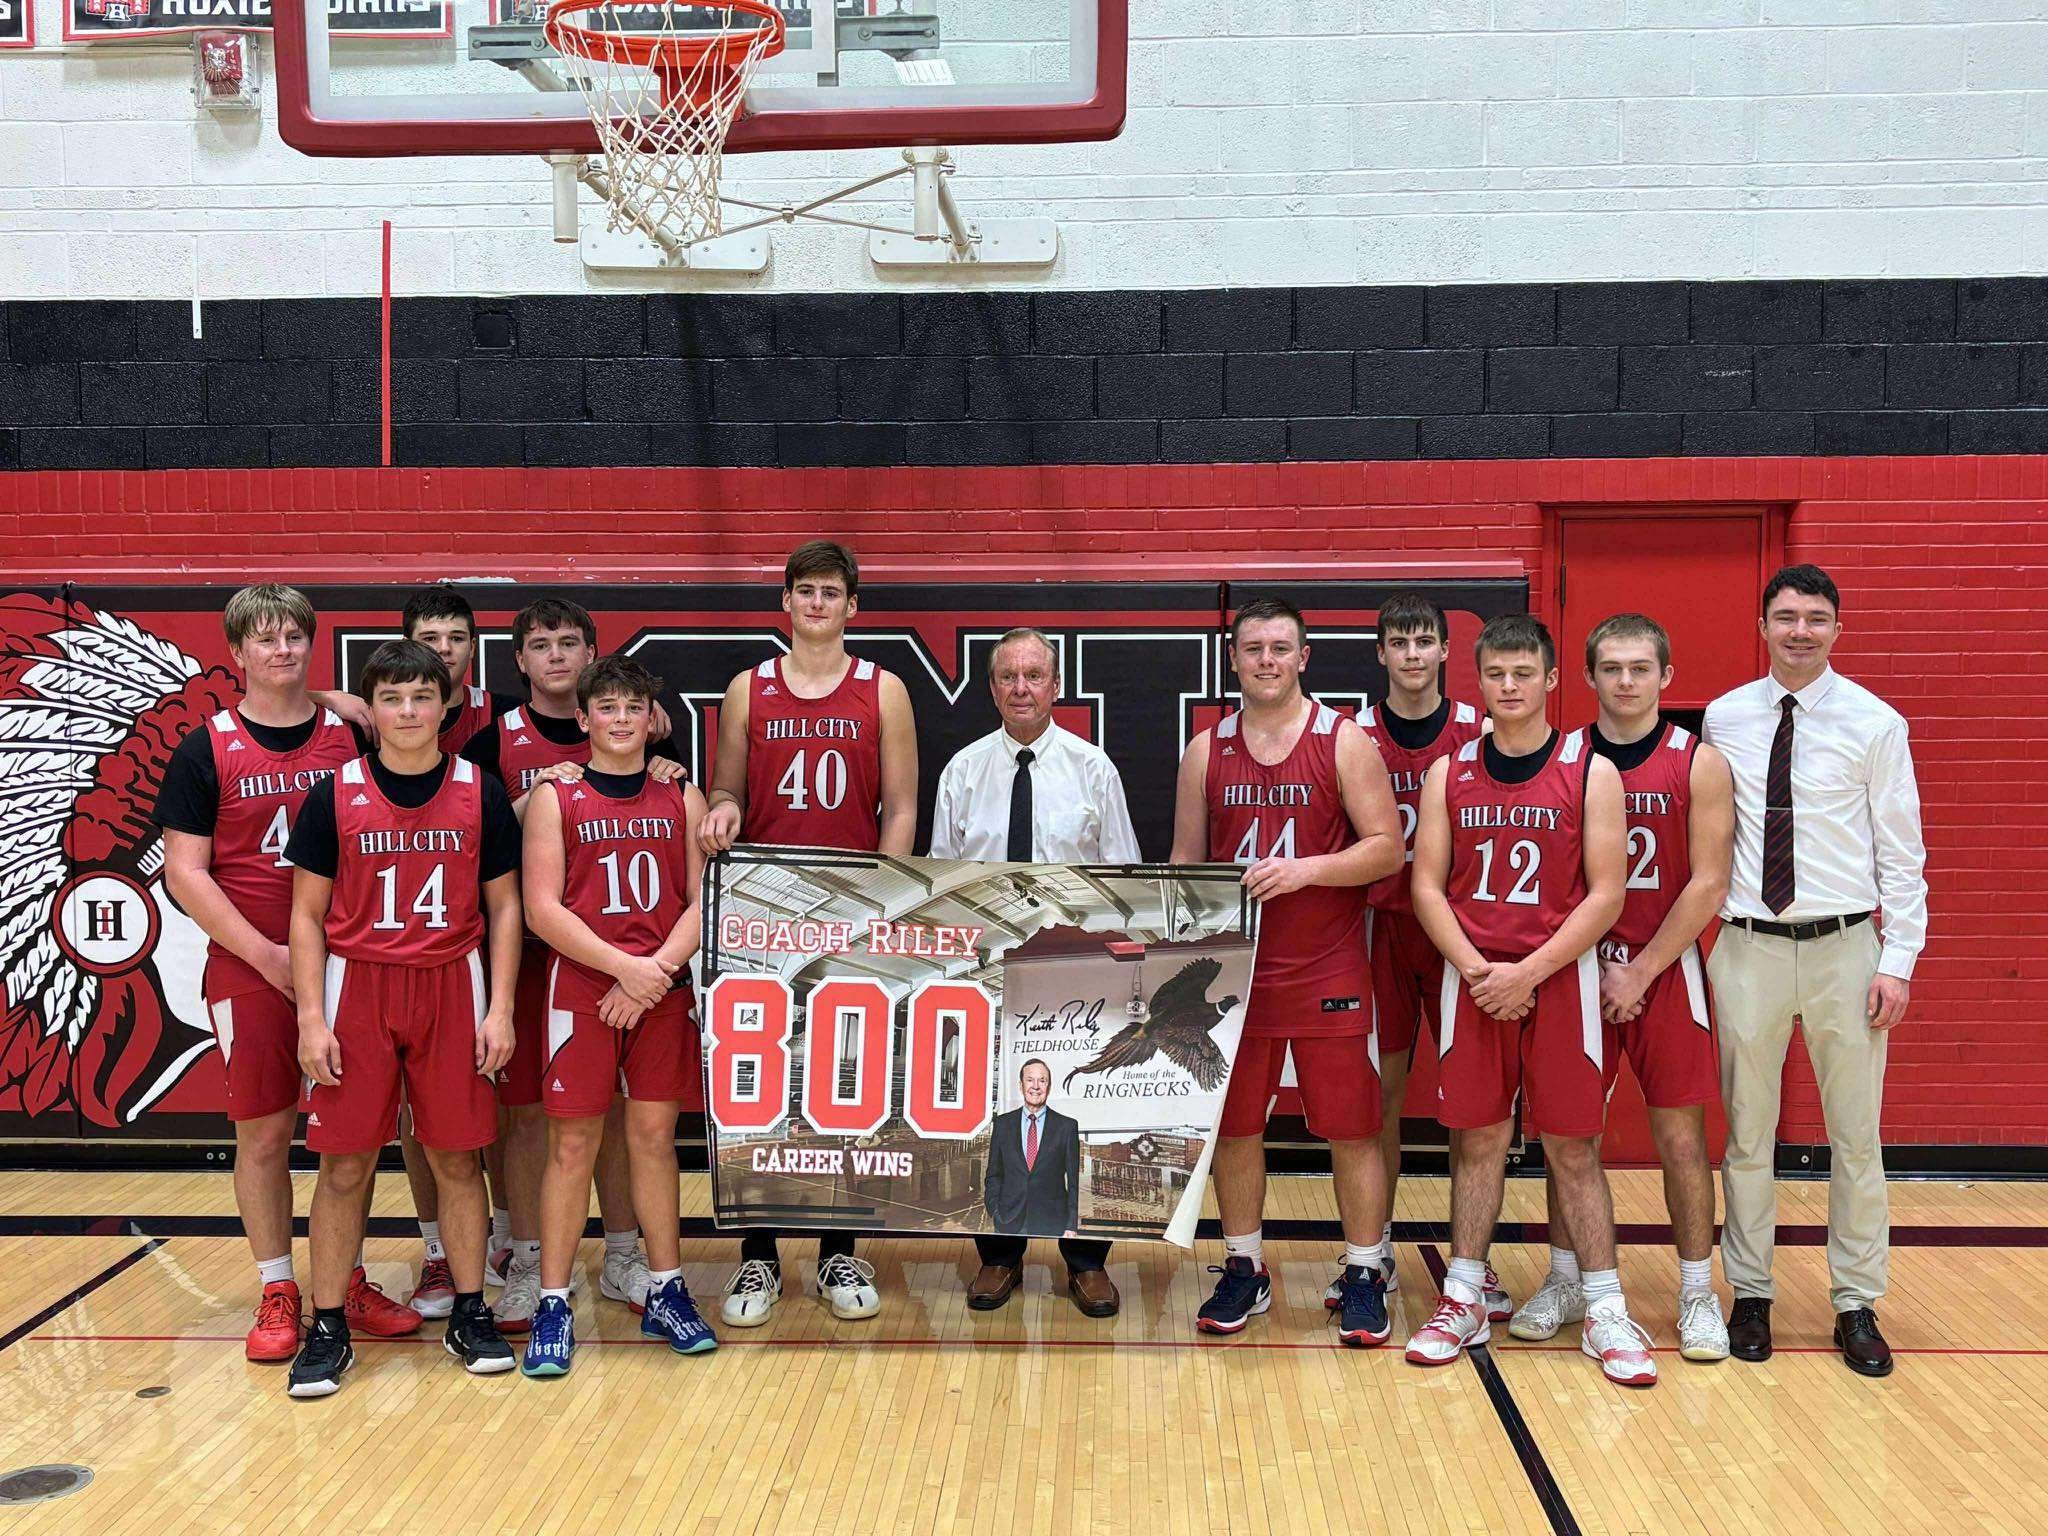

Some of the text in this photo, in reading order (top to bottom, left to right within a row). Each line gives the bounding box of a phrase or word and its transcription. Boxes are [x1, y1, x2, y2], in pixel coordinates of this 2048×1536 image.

[765, 718, 861, 740] HILL CITY
[239, 773, 293, 798] HILL
[777, 749, 847, 810] 40
[1223, 784, 1313, 807] HILL CITY
[1460, 805, 1562, 830] HILL CITY
[358, 830, 464, 854] HILL CITY
[576, 818, 674, 843] HILL CITY
[1233, 817, 1295, 864] 44
[597, 850, 660, 915] 10
[1471, 838, 1541, 905] 12
[372, 863, 449, 930] 14
[721, 913, 983, 958] COACH RILEY
[706, 972, 996, 1140] 800
[1013, 1038, 1100, 1054] FIELDHOUSE
[1122, 1069, 1176, 1080] Home of the
[1083, 1080, 1191, 1099] RINGNECKS
[752, 1147, 913, 1177] CAREER WINS
